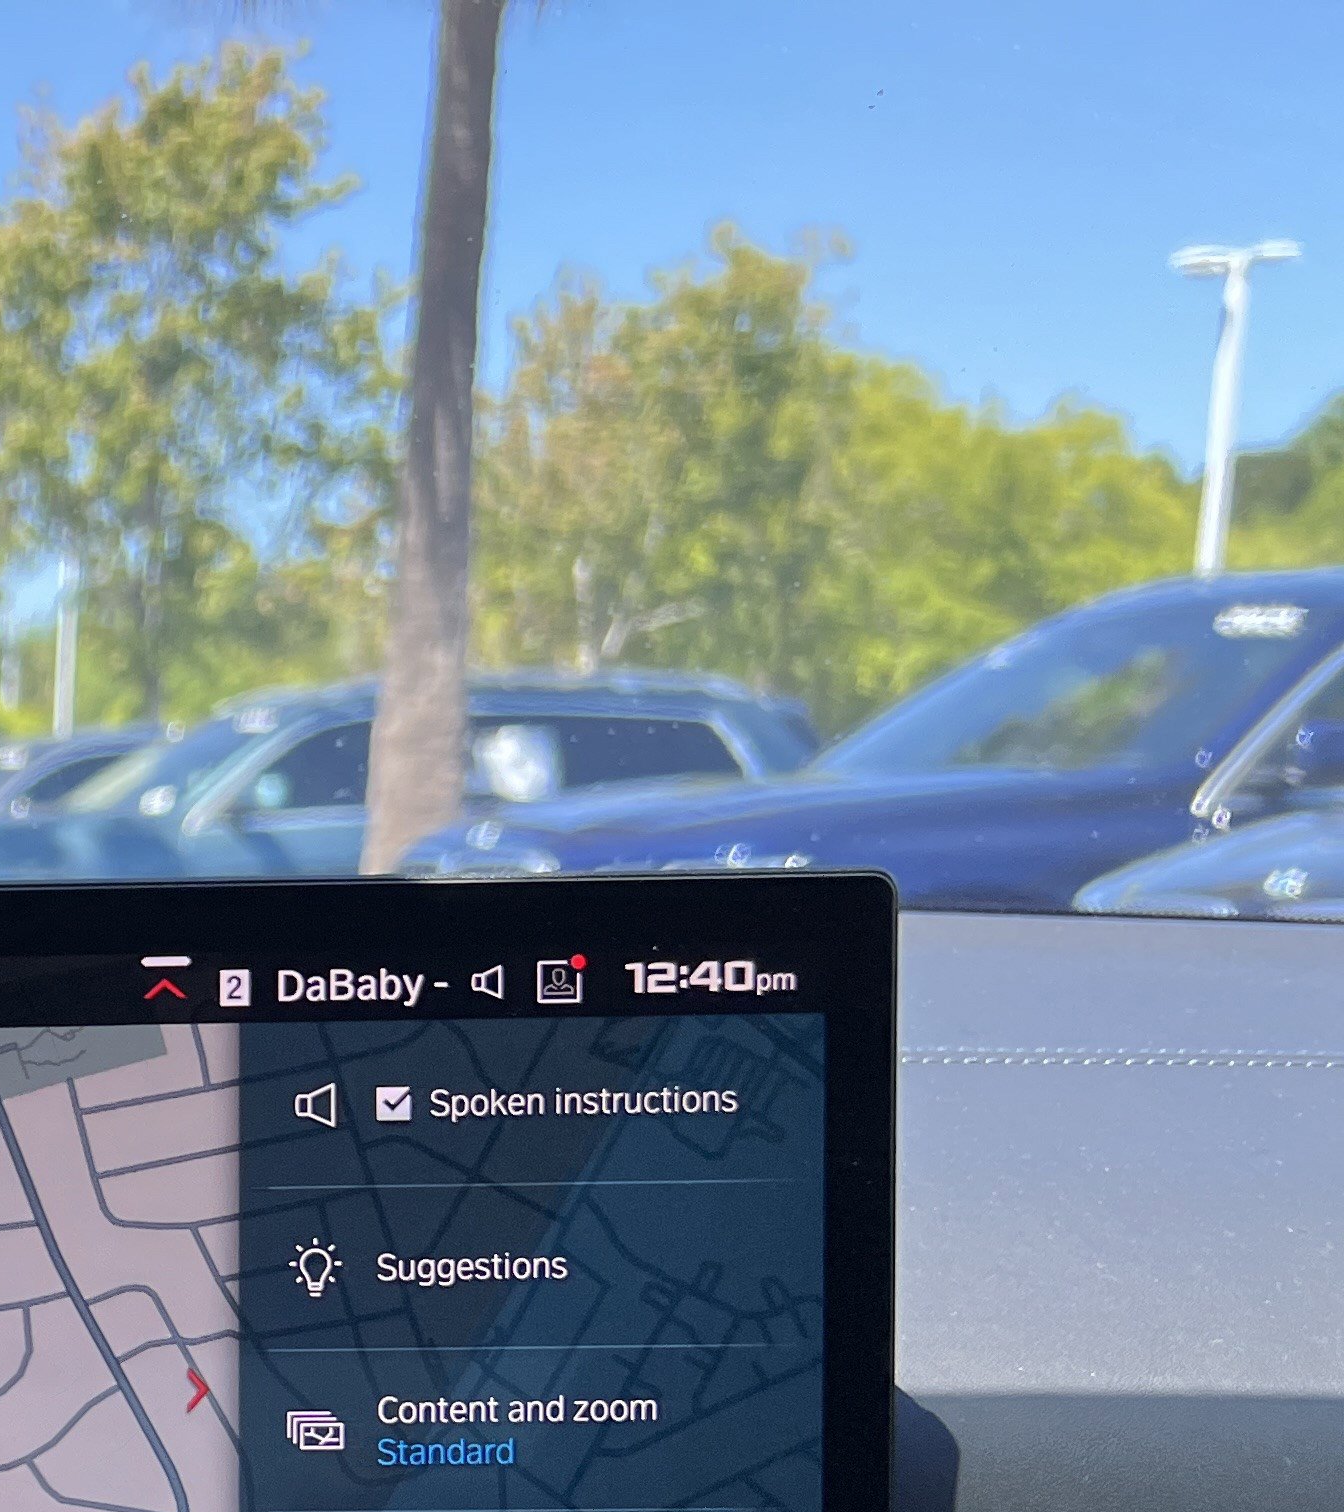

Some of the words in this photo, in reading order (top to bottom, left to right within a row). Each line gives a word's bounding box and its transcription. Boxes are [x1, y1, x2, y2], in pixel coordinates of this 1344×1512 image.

[277, 967, 425, 1007] DaBaby
[429, 1088, 545, 1122] Spoken
[555, 1085, 739, 1115] instructions
[377, 1251, 568, 1287] Suggestions
[377, 1395, 500, 1424] Content
[507, 1394, 565, 1423] and
[572, 1399, 658, 1422] zoom
[377, 1437, 515, 1466] Standard
